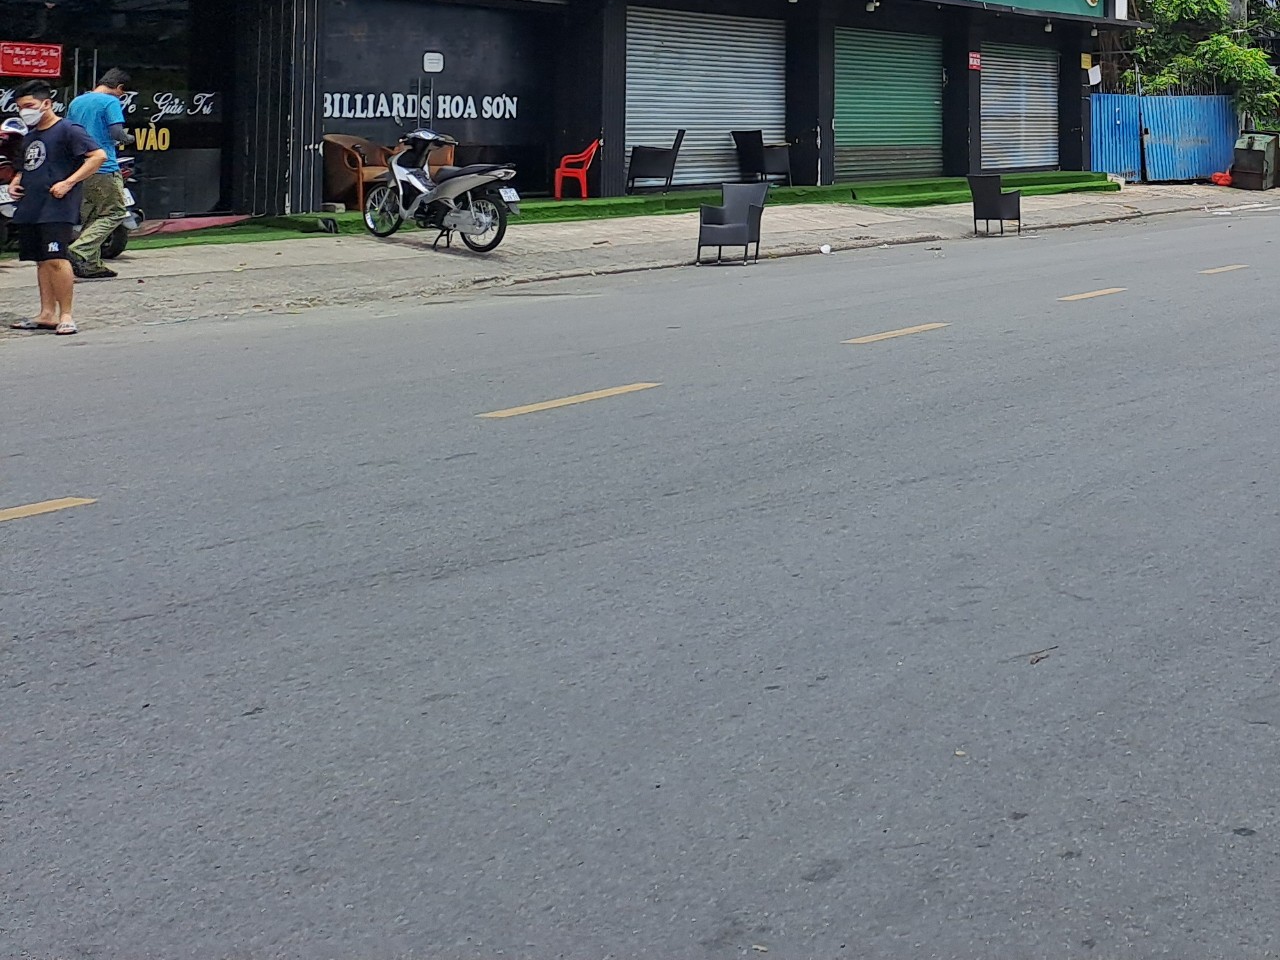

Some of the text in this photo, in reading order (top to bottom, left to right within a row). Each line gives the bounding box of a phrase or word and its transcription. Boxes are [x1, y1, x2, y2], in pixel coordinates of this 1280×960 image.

[323, 93, 518, 120] BILLIARDS HOA SƠN
[134, 122, 171, 151] VÀO
